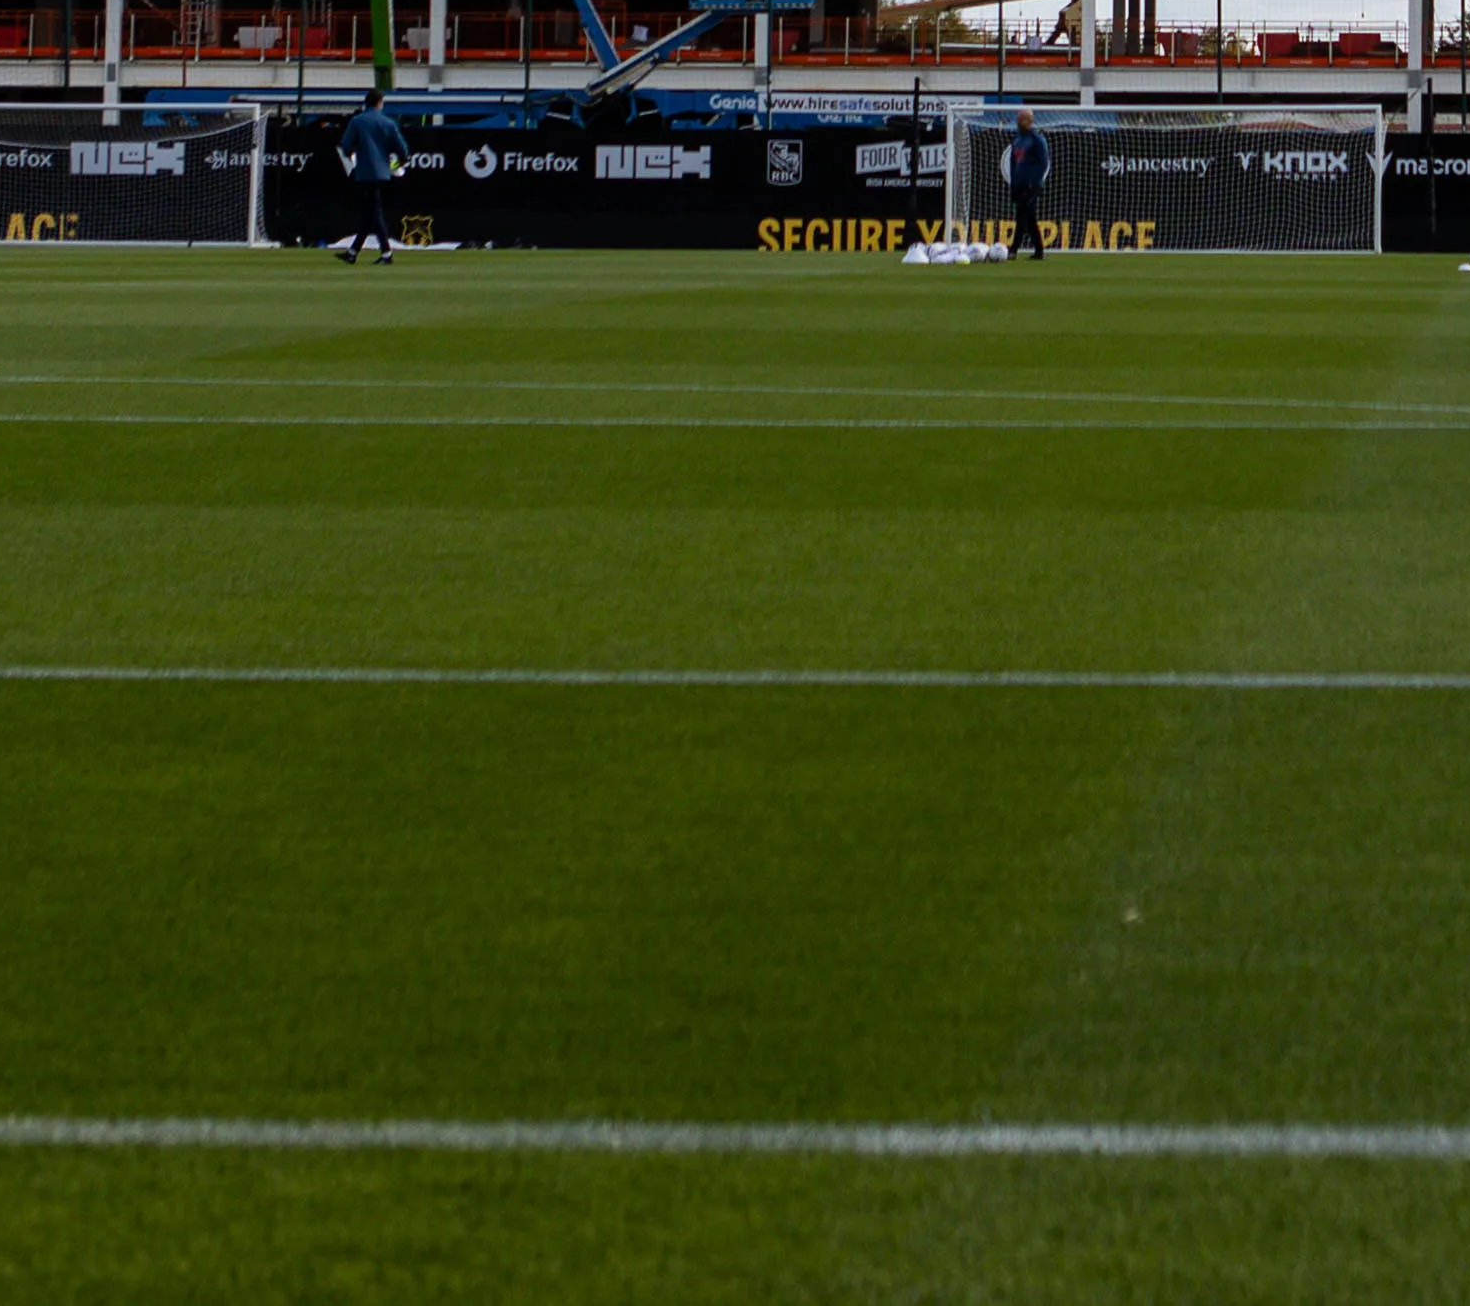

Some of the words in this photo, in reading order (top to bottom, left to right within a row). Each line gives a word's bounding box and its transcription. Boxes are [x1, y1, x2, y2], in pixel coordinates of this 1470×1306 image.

[709, 93, 757, 109] Genie
[503, 152, 578, 172] Firefox
[861, 146, 898, 169] FOUR
[1127, 155, 1211, 177] ancestry
[757, 217, 906, 253] SECURE
[1036, 219, 1156, 252] PLACE
